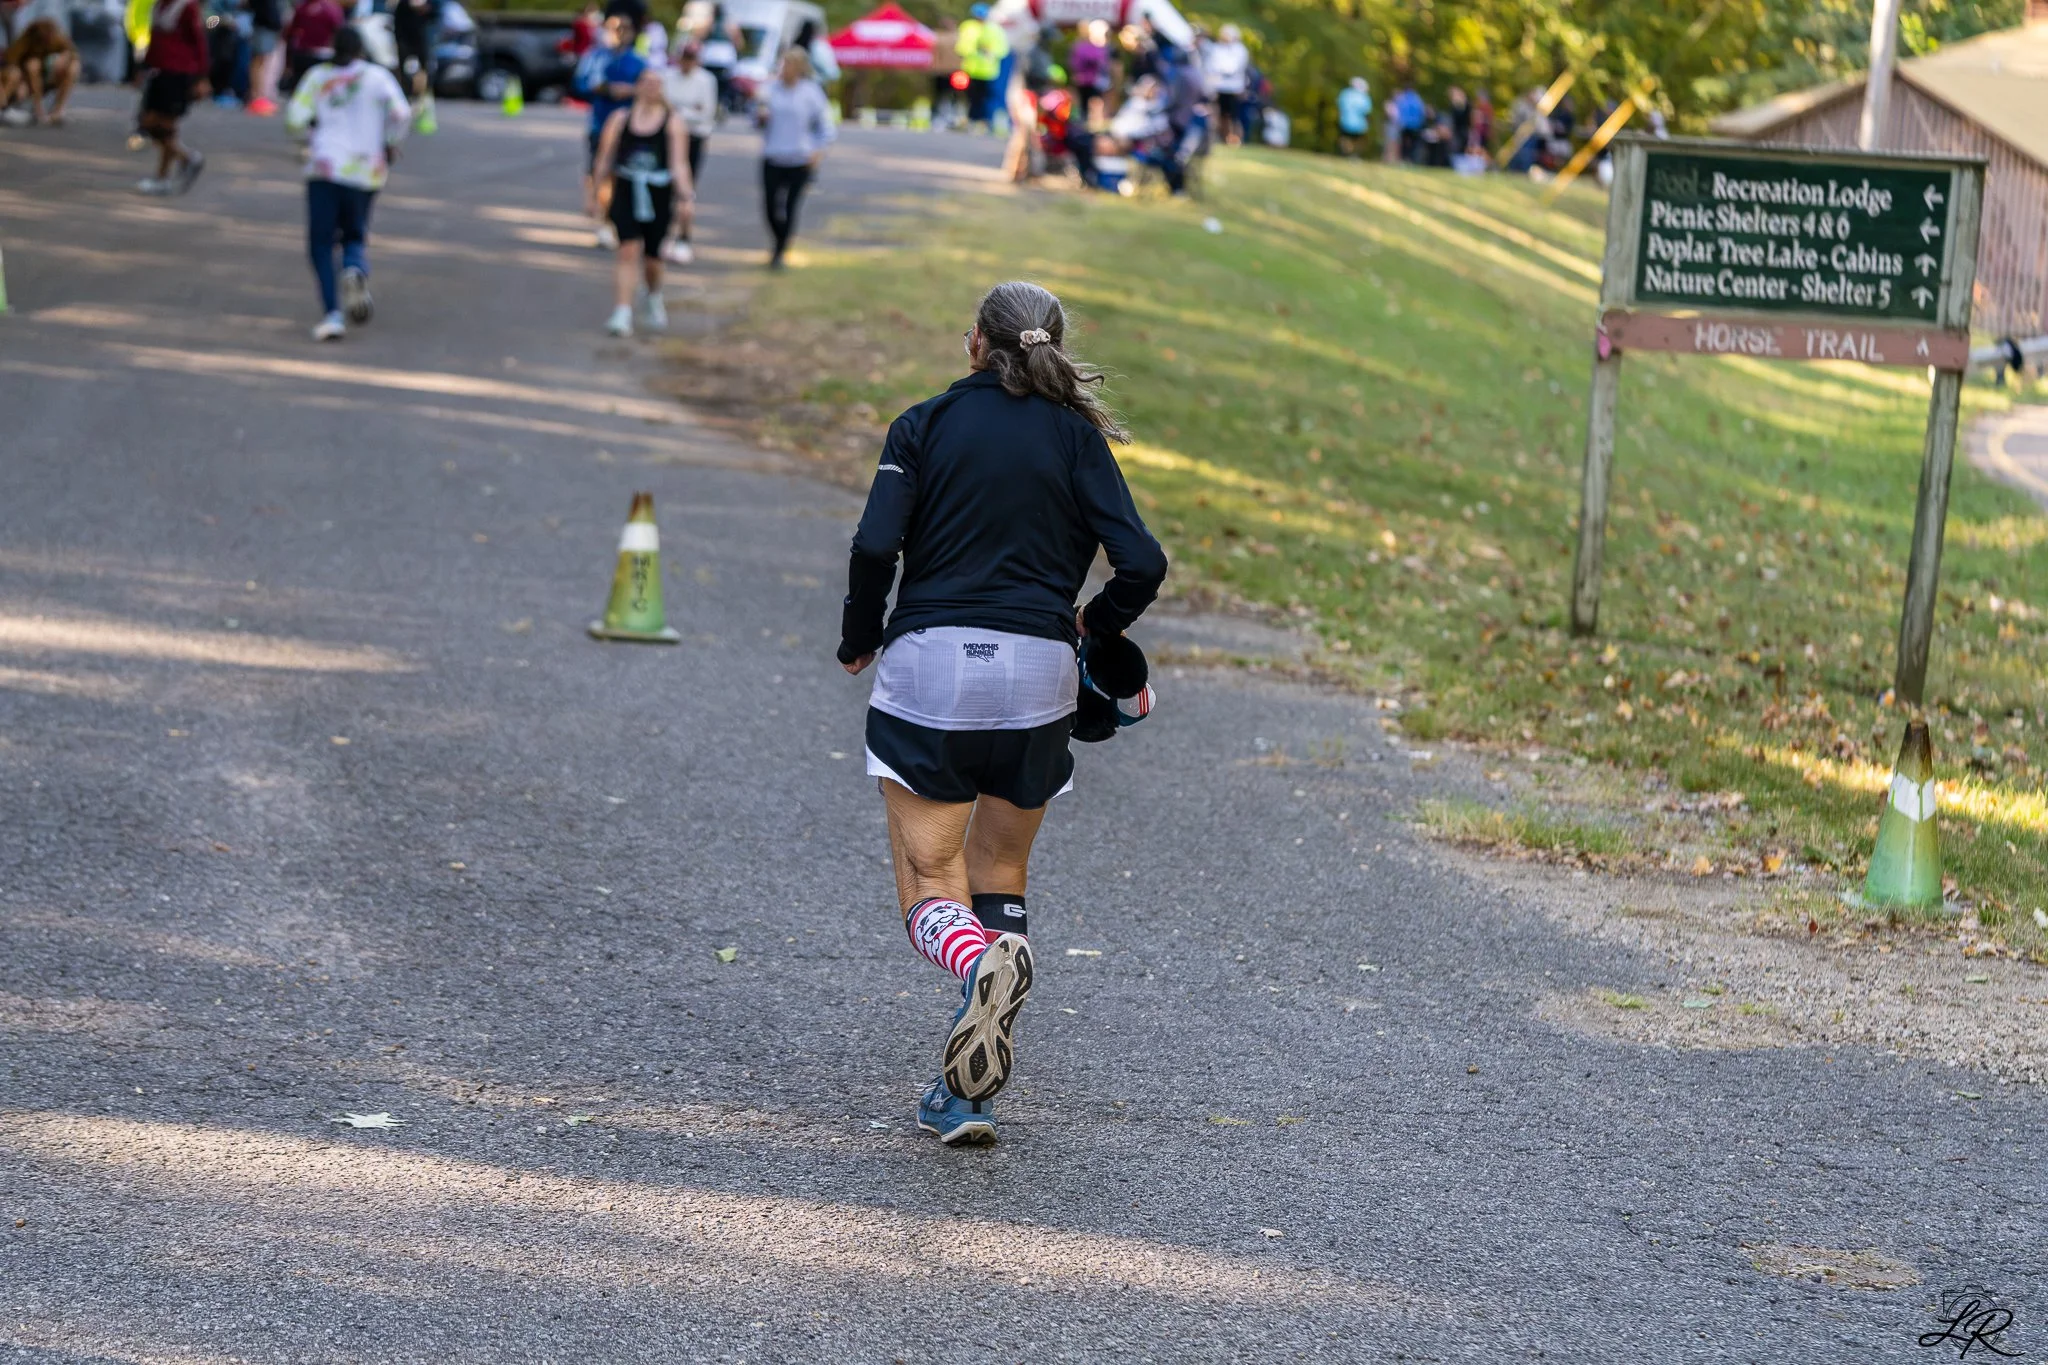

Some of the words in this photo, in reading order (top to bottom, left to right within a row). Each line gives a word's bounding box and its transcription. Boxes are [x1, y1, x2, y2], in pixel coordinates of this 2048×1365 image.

[1712, 171, 1824, 206] Recreation
[1828, 178, 1893, 218] Lodge
[1650, 200, 1714, 232] Picnic
[1715, 202, 1800, 237] Shelters
[1802, 211, 1816, 239] 4
[1818, 212, 1834, 240] &
[1836, 211, 1850, 241] 6
[1647, 232, 1716, 270] Poplar
[1718, 236, 1764, 266] Tree
[1767, 239, 1818, 270] Lake
[1831, 243, 1903, 276] Cabins
[1644, 264, 1715, 296] Nature
[1717, 269, 1789, 300] Center
[1801, 272, 1876, 306] Shelter
[1877, 279, 1892, 309] 5
[1694, 321, 1782, 356] HORSE
[1803, 328, 1884, 362] TRAIL
